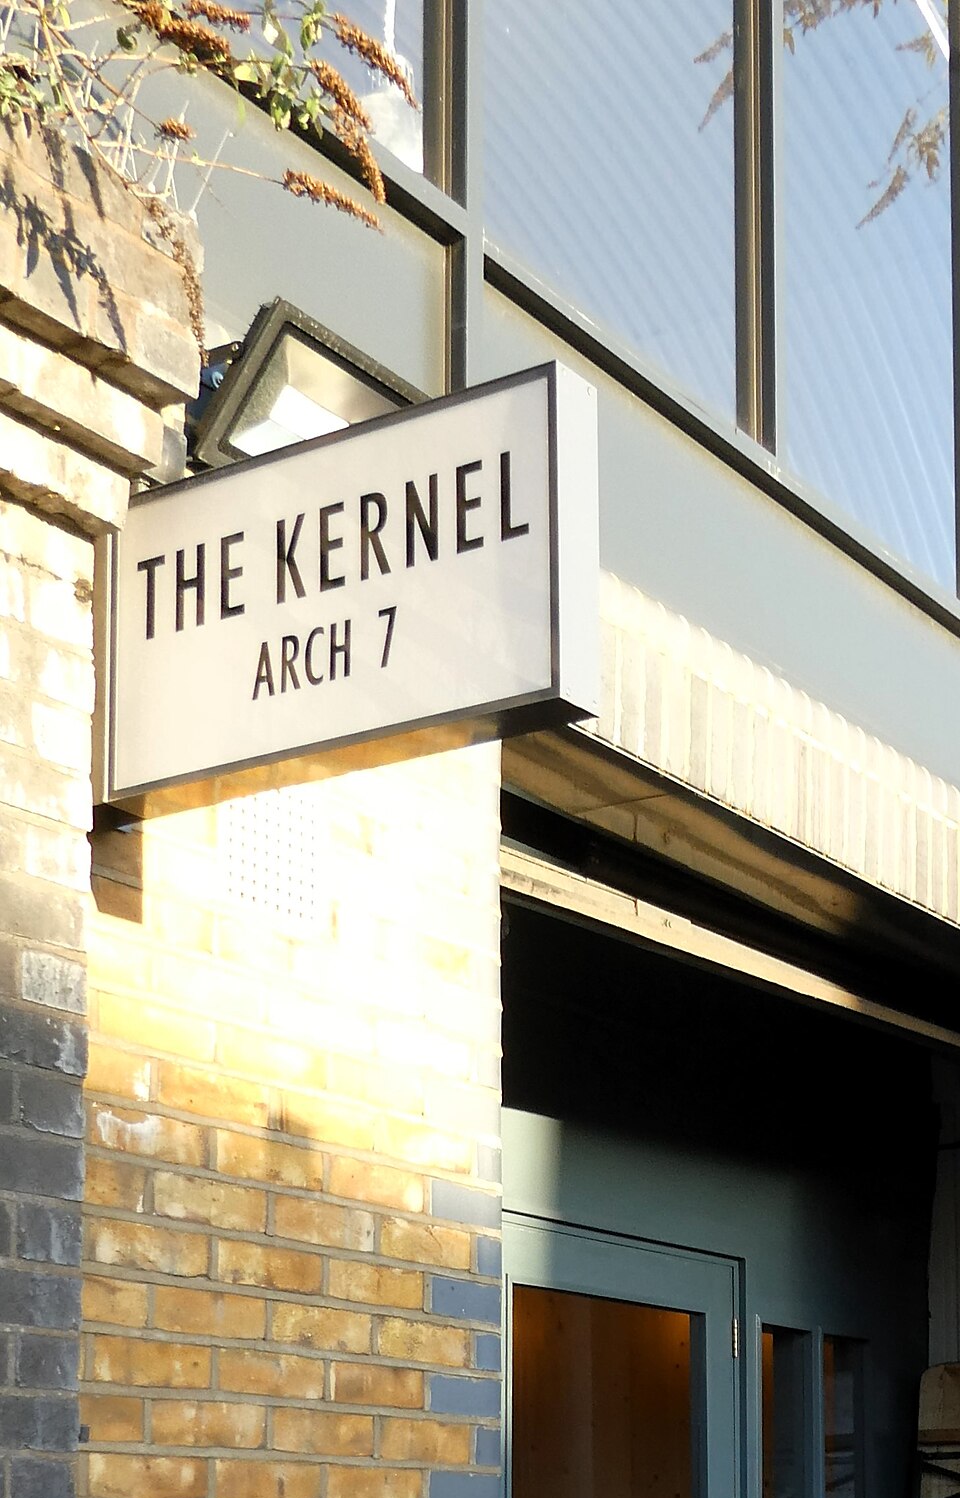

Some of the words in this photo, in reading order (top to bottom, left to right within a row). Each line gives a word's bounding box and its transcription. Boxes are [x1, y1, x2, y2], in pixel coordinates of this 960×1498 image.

[137, 531, 246, 640] THE
[276, 450, 530, 604] KERNEL
[252, 619, 351, 701] ARCH
[378, 605, 398, 668] 7
